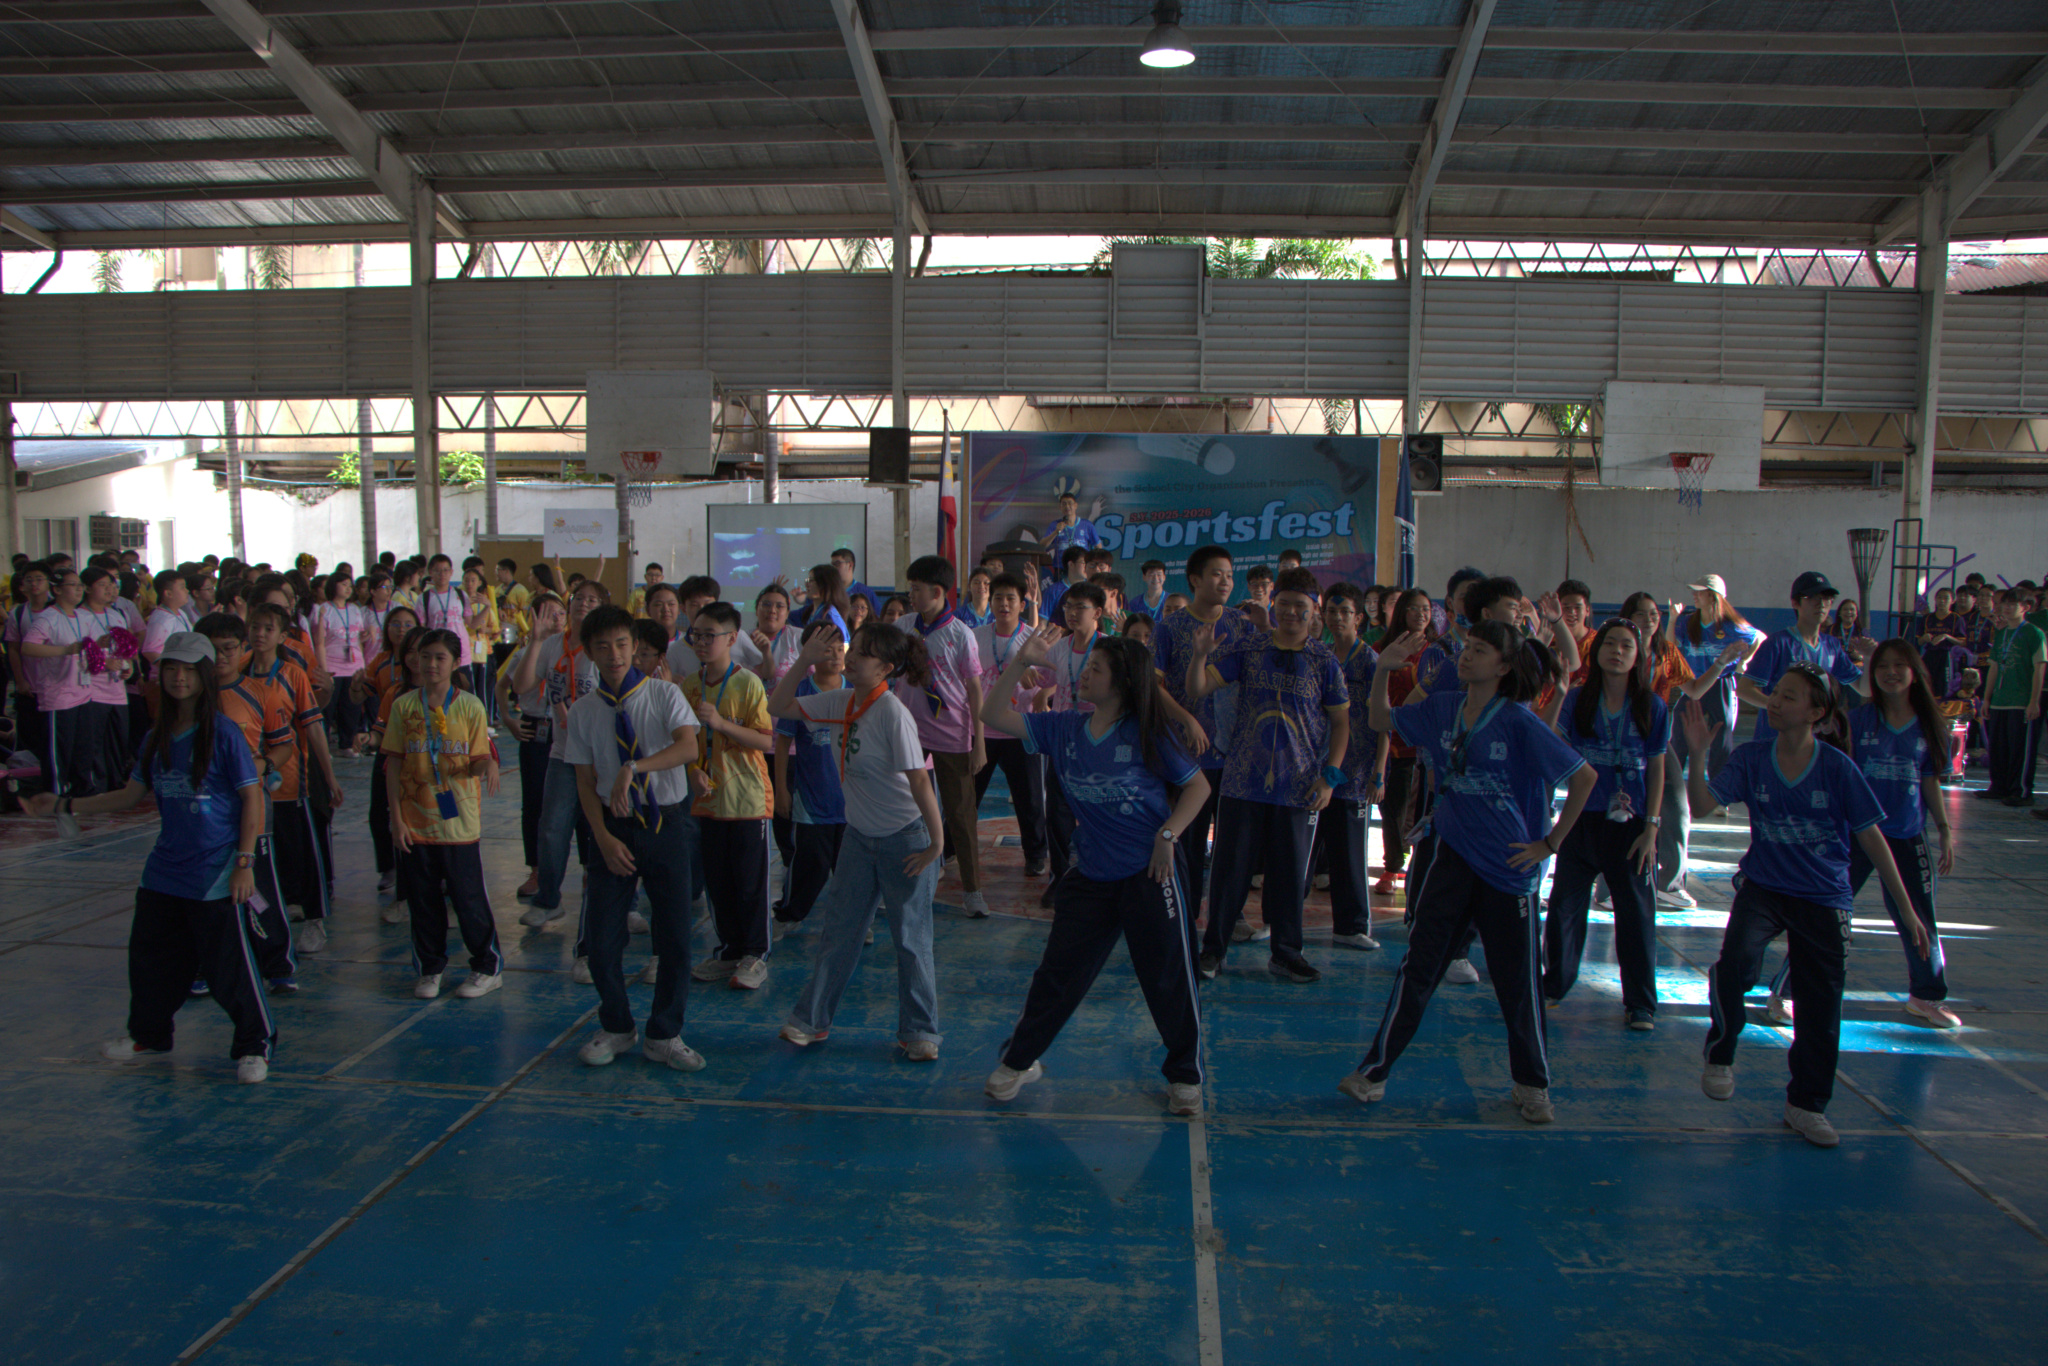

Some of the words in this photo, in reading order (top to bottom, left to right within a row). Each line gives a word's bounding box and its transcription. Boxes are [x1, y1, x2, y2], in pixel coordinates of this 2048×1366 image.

[1115, 484, 1131, 494] the
[1197, 480, 1267, 493] Organization
[1130, 511, 1148, 523] S.Y.
[1150, 508, 1212, 521] 2025-2026
[1097, 500, 1355, 560] Sportsfest
[1489, 741, 1507, 761] 13
[1915, 844, 1931, 894] HOPE
